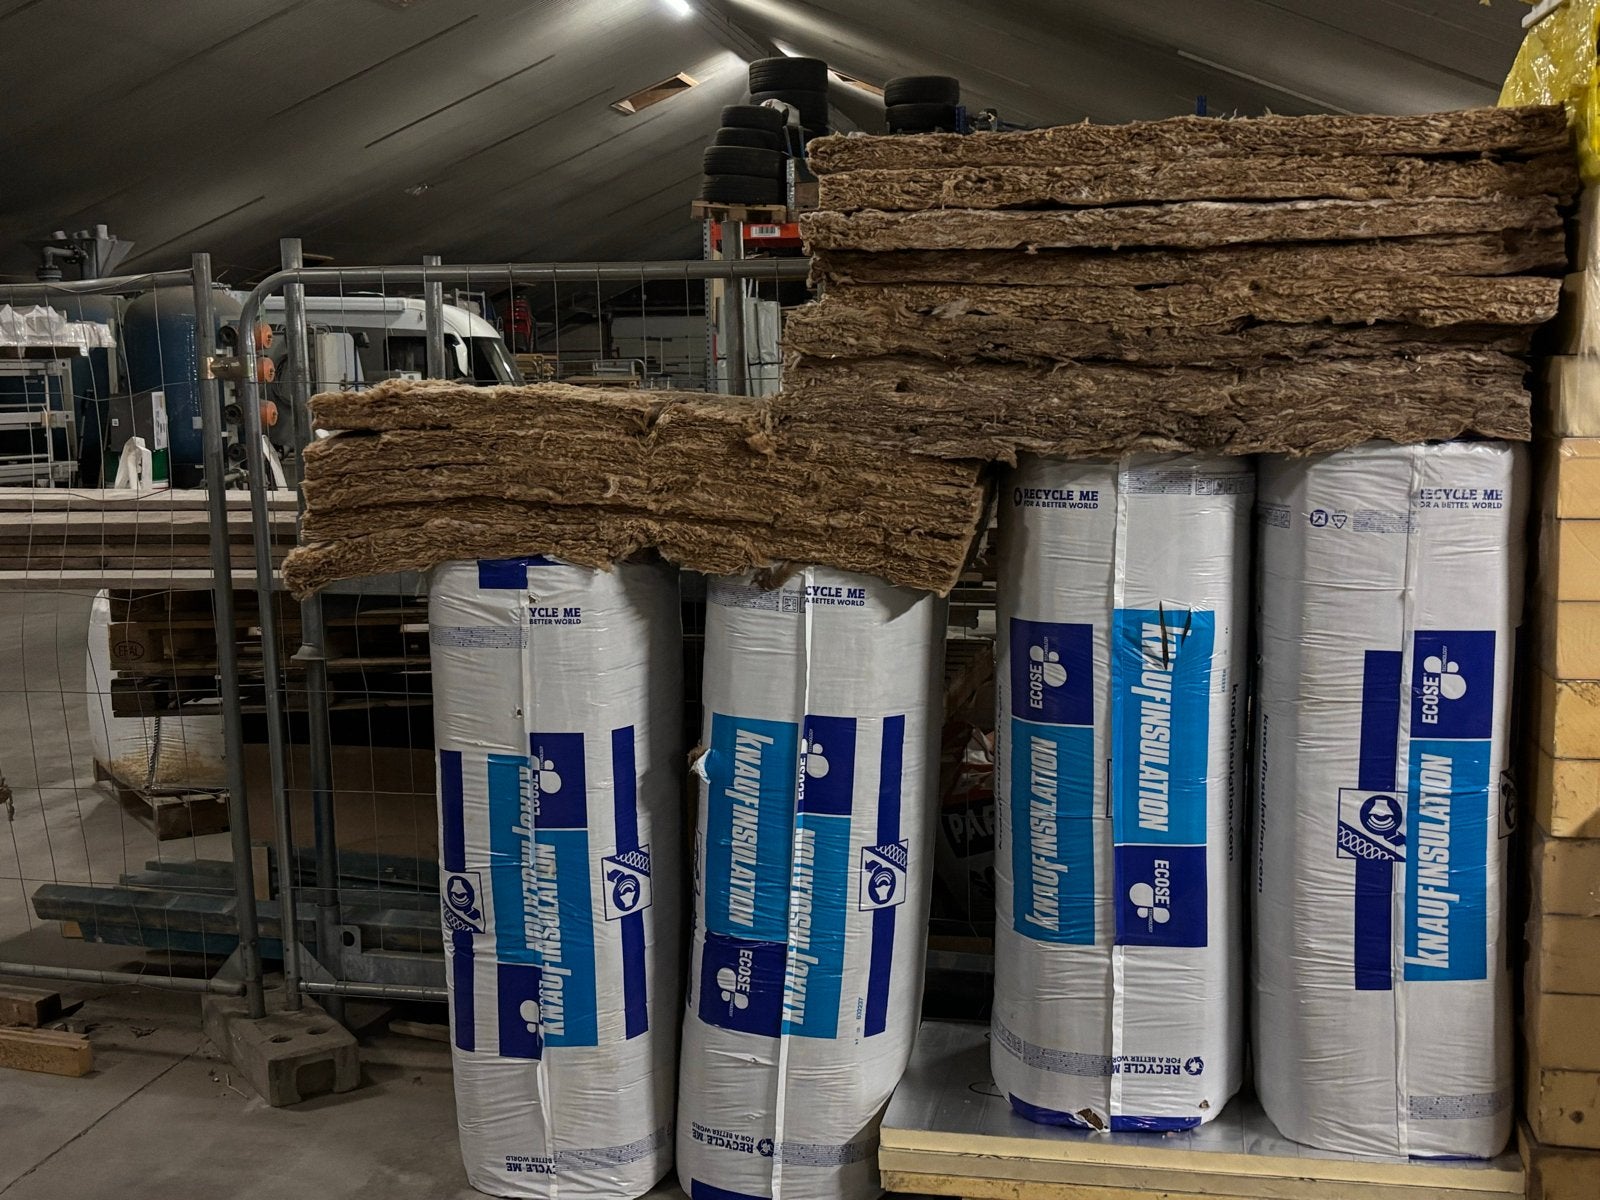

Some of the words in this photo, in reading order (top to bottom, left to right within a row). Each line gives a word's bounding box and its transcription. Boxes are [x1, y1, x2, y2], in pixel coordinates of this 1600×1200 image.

[1024, 489, 1074, 501] RECYCLE
[1079, 491, 1099, 501] ME
[1482, 489, 1503, 500] ME
[805, 586, 842, 597] CYCLE
[847, 588, 865, 599] ME
[812, 597, 835, 605] BETTER
[837, 599, 865, 607] WORLD
[529, 608, 558, 617] YCLE
[563, 608, 581, 617] ME
[1029, 664, 1043, 709] ECOSE
[1422, 677, 1439, 724] ECOSE
[1154, 859, 1170, 905] ECOSE
[737, 949, 753, 992] ECOSE
[1124, 1063, 1181, 1075] RECYCLE
[712, 1129, 733, 1139] BETTER
[740, 1134, 754, 1143] FOR
[706, 1135, 754, 1154] RECYCLE
[505, 1162, 522, 1172] ME
[526, 1163, 552, 1174] YCLE
